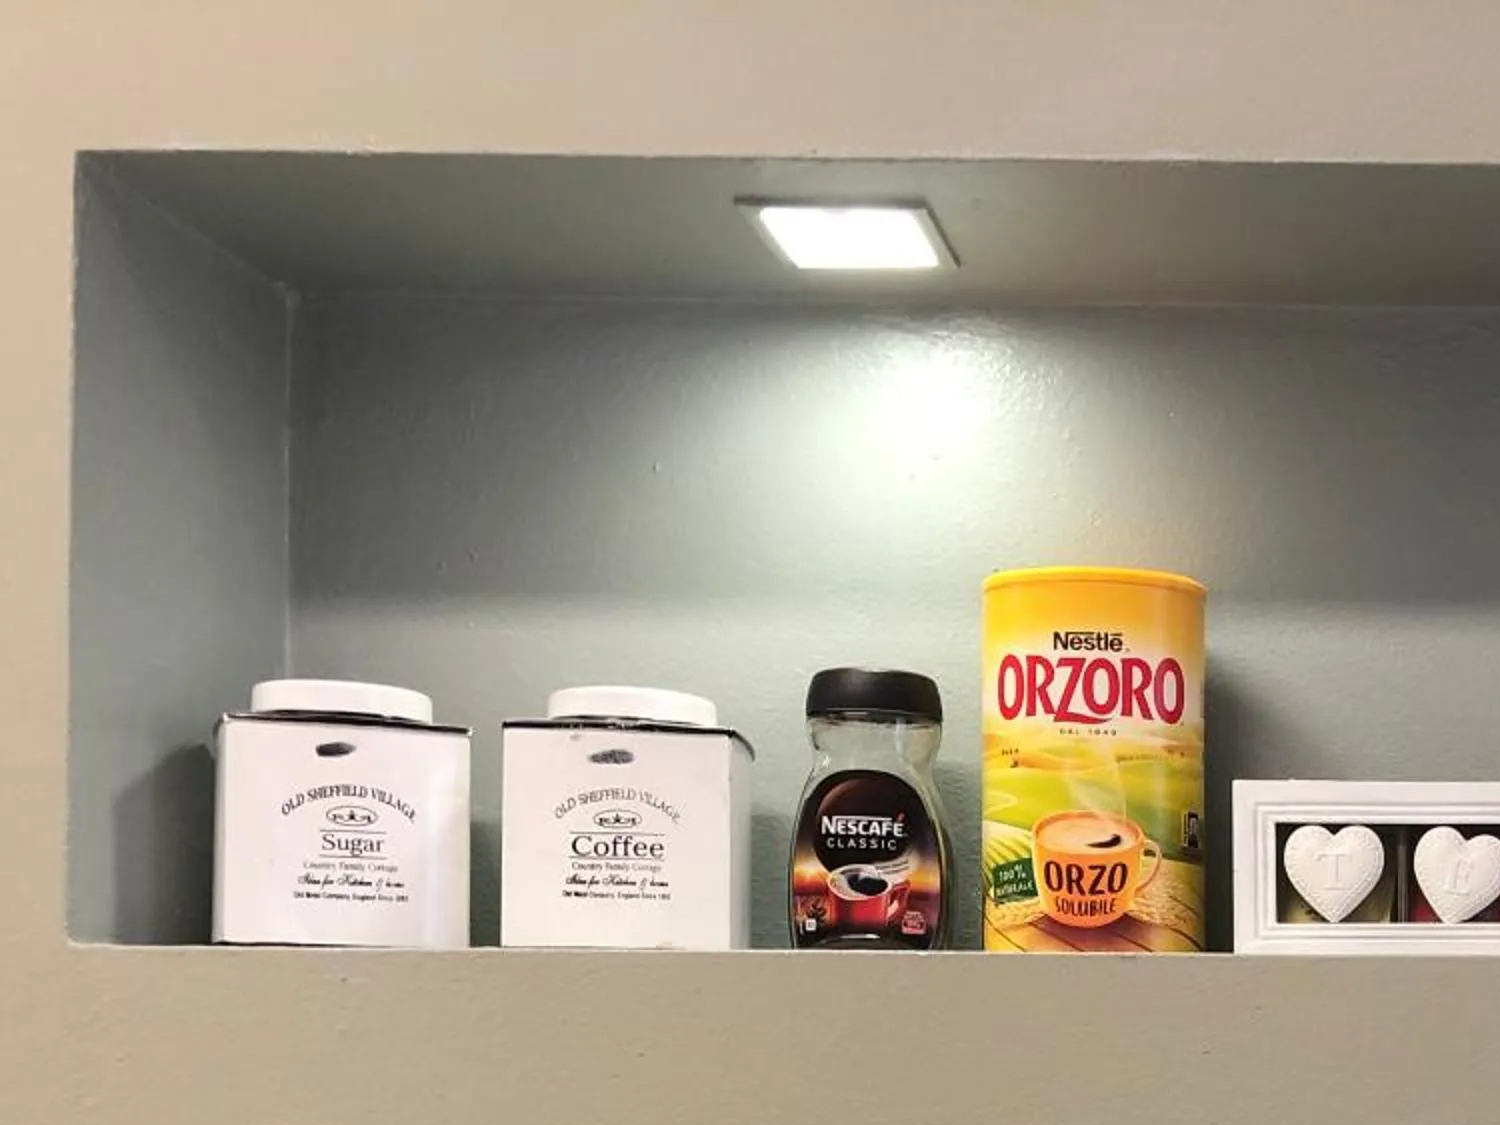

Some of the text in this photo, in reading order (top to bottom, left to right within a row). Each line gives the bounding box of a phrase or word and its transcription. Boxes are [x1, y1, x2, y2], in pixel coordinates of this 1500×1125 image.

[997, 654, 1185, 724] ORZORO
[281, 793, 304, 815] OLD
[555, 797, 577, 819] OLD
[322, 833, 385, 857] Sugar
[571, 835, 664, 858] Coffee
[826, 837, 897, 850] CLASSIC
[1043, 861, 1128, 896] ORZO
[1055, 896, 1116, 917] SOLUBILE
